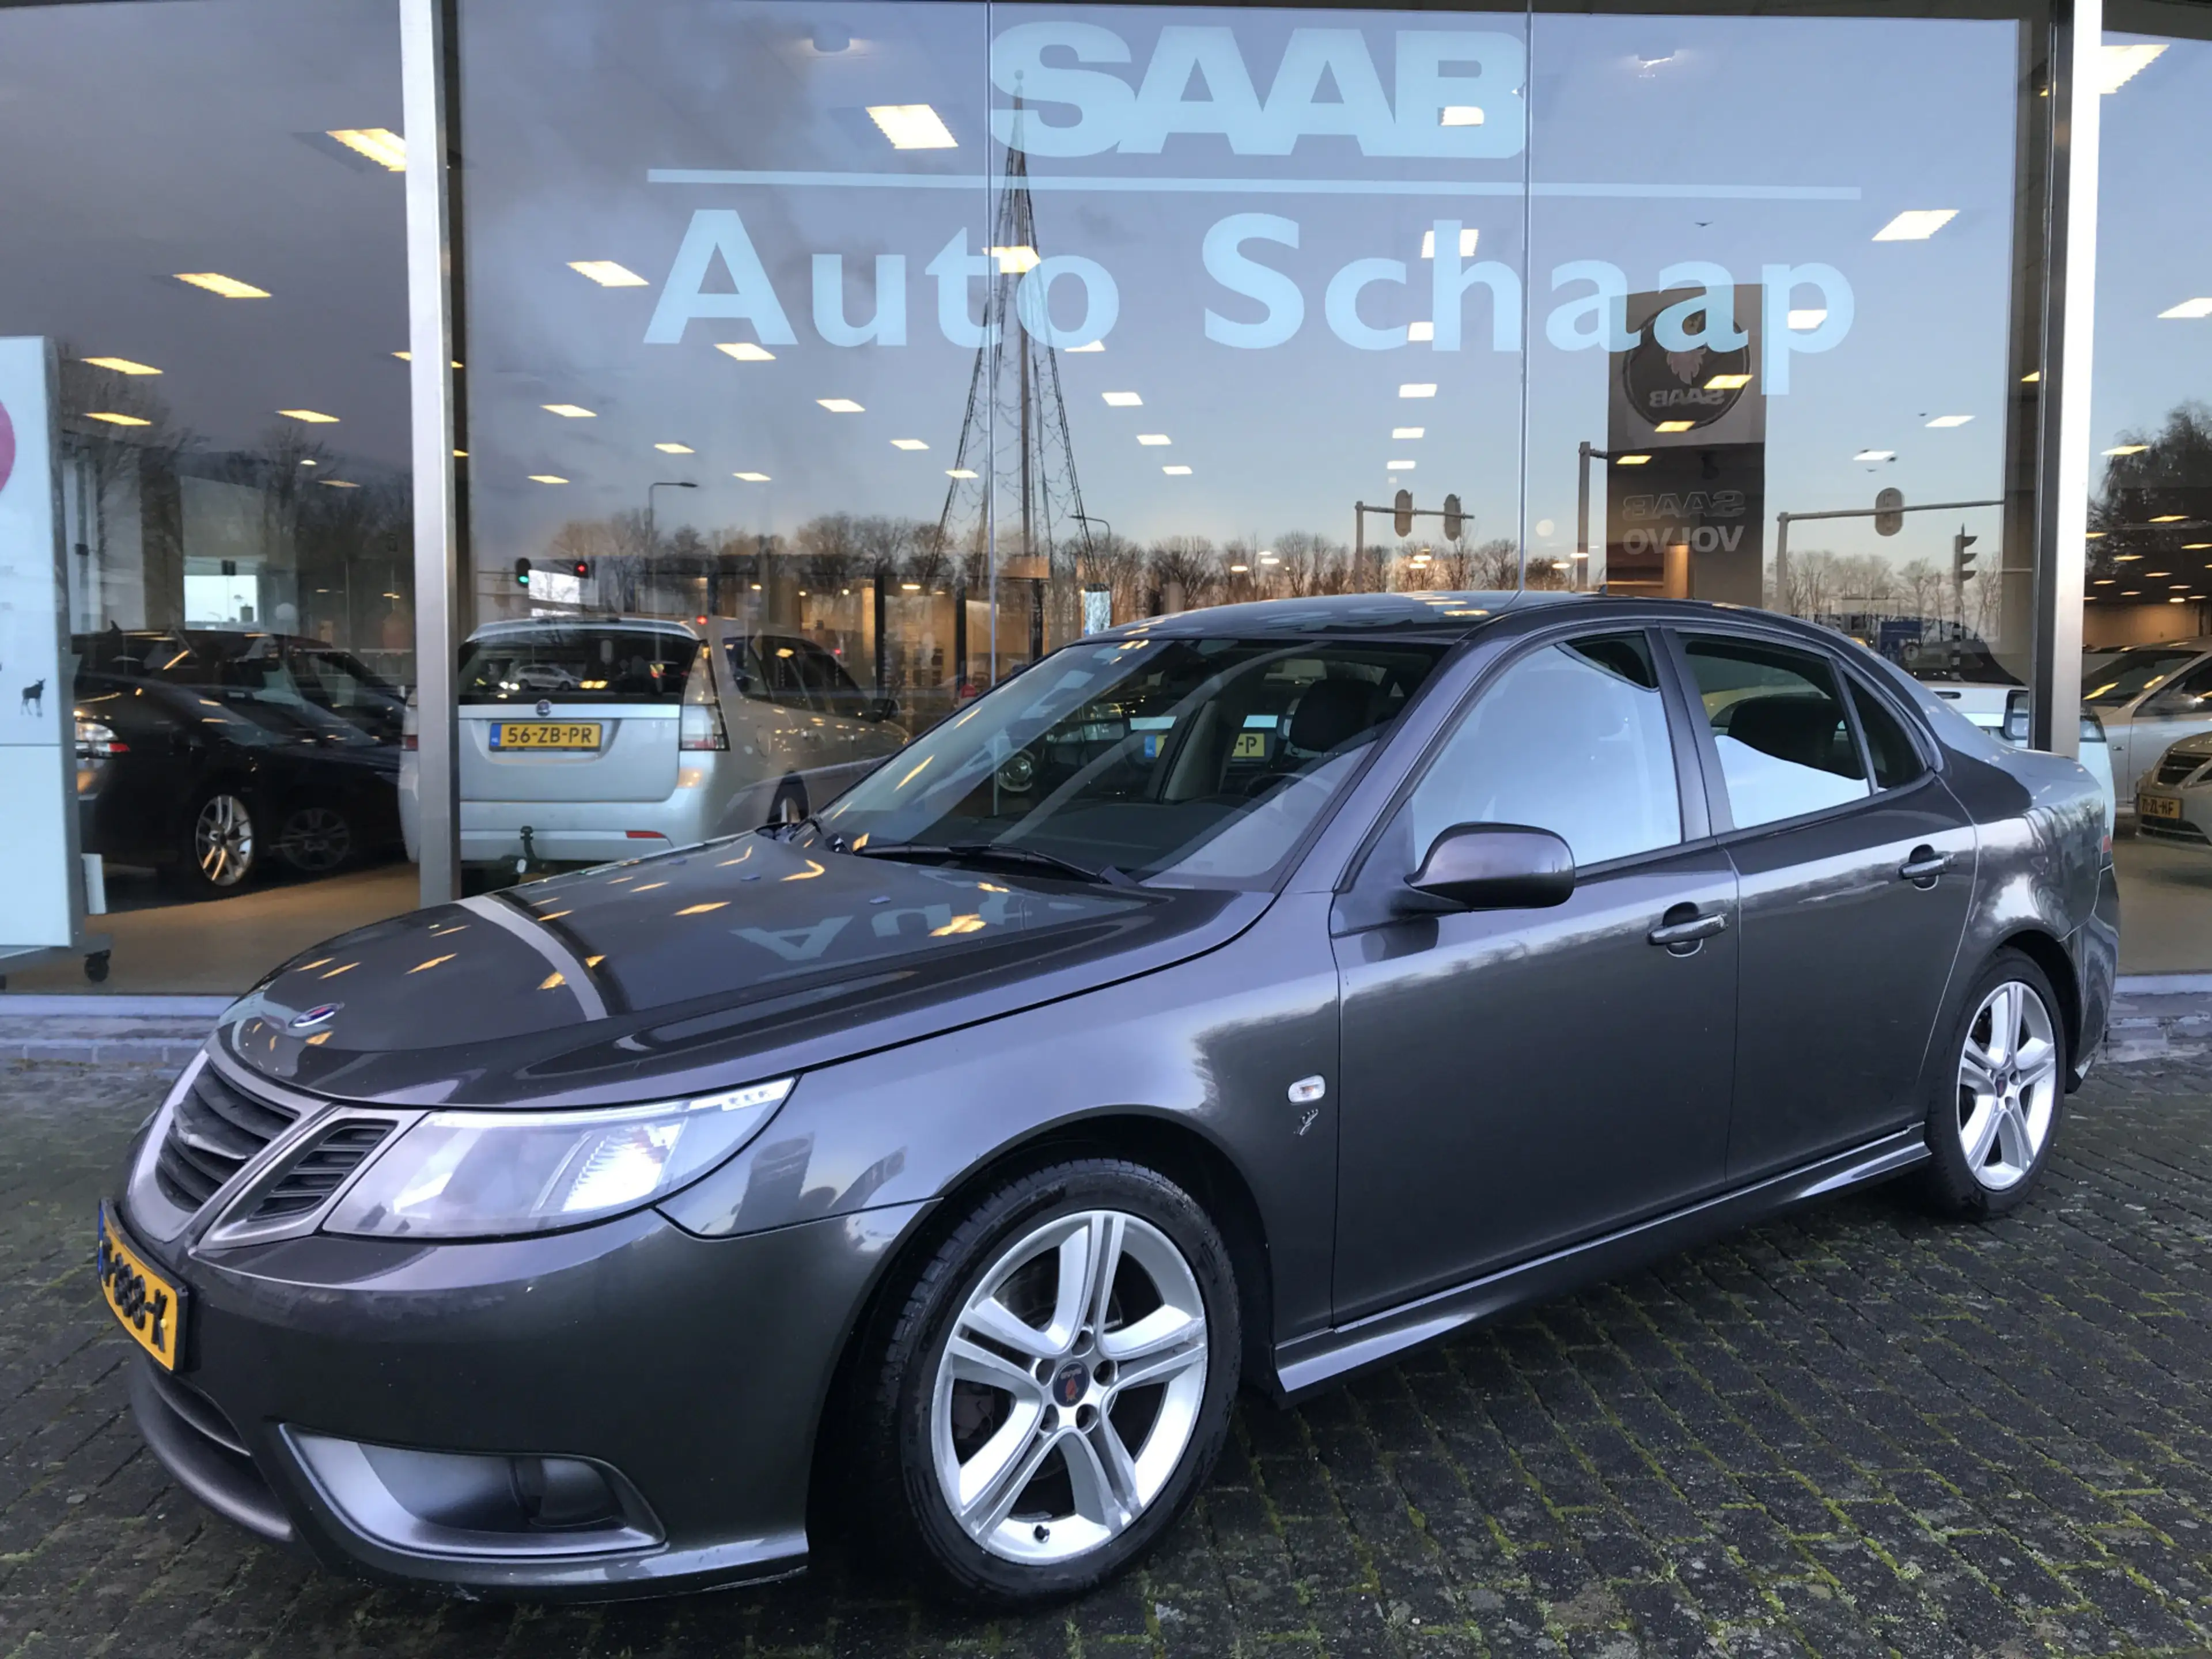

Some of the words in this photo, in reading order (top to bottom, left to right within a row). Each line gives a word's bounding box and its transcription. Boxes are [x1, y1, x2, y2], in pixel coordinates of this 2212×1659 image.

[989, 21, 1526, 159] SAAB
[643, 209, 1119, 349] Auto
[1202, 213, 1854, 395] Schaap
[507, 726, 592, 744] 56-ZB-PR
